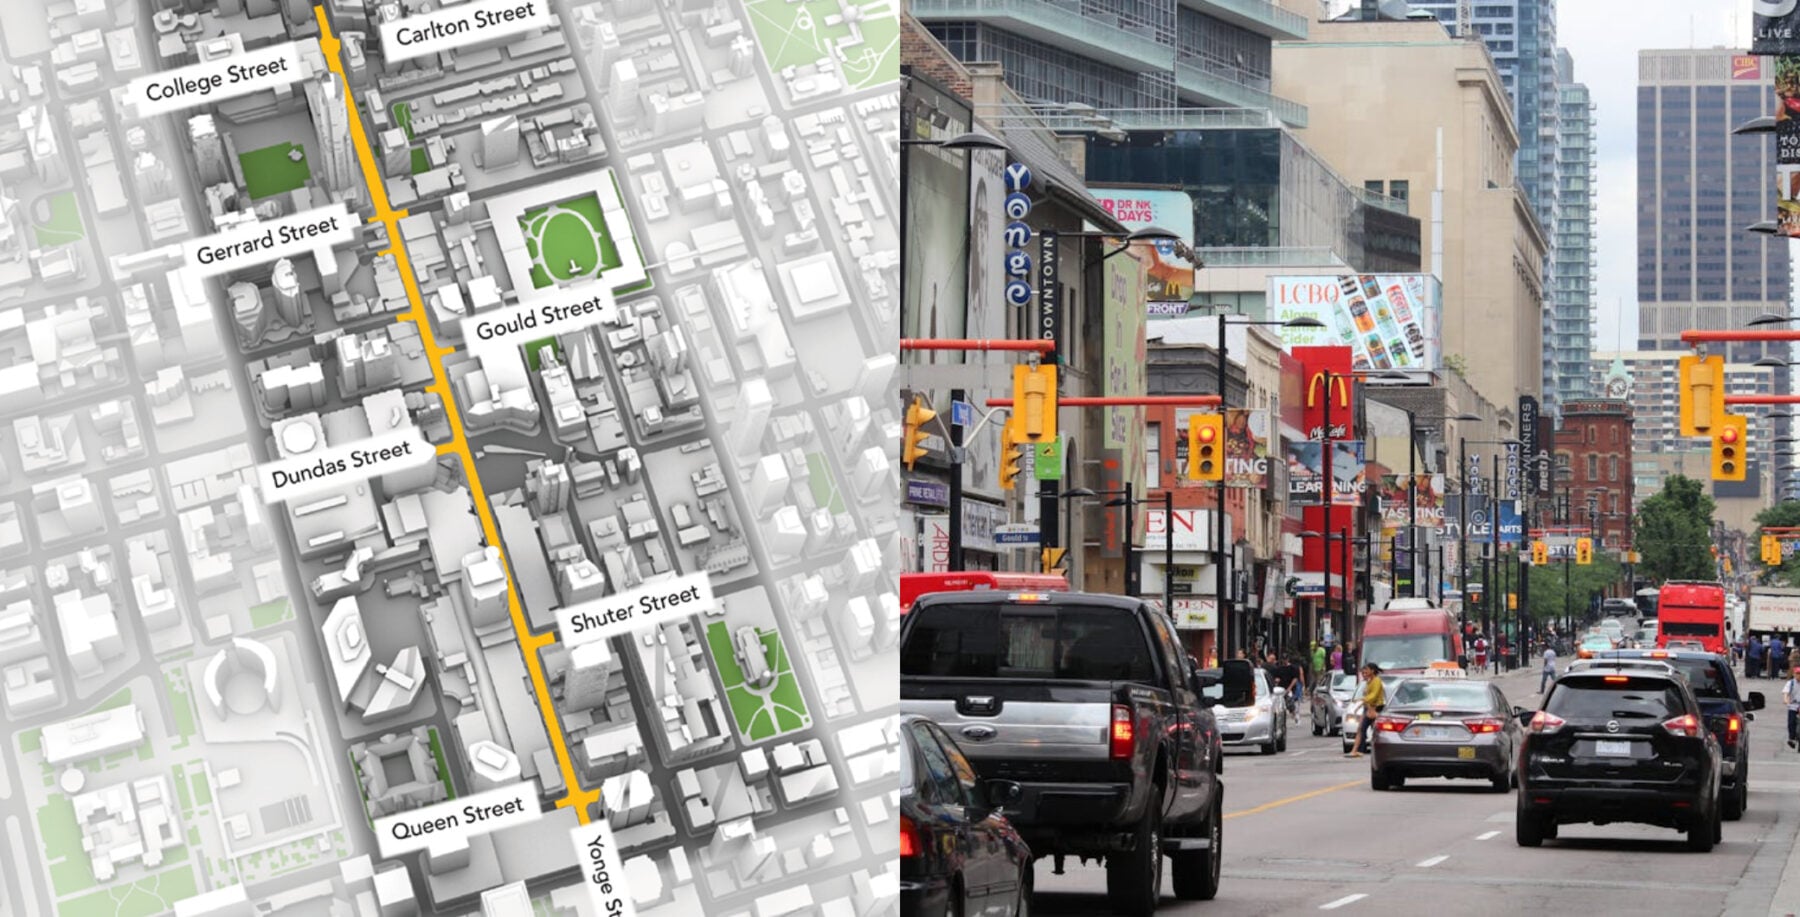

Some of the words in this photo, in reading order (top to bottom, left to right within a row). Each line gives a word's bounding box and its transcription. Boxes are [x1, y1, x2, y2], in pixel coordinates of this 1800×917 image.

[1759, 28, 1792, 38] LIVE
[1734, 57, 1757, 67] CIBC
[1118, 210, 1152, 222] DAYS
[1006, 164, 1030, 306] Yonge
[1043, 237, 1054, 339] DOWNTOWN
[1280, 283, 1339, 304] LCBO
[1281, 332, 1314, 344] Cider
[1522, 403, 1532, 469] WINNERS
[1176, 458, 1267, 474] TATING
[1289, 481, 1367, 493] LEARNING
[1002, 534, 1021, 542] Gould
[1436, 668, 1460, 677] TAXI
